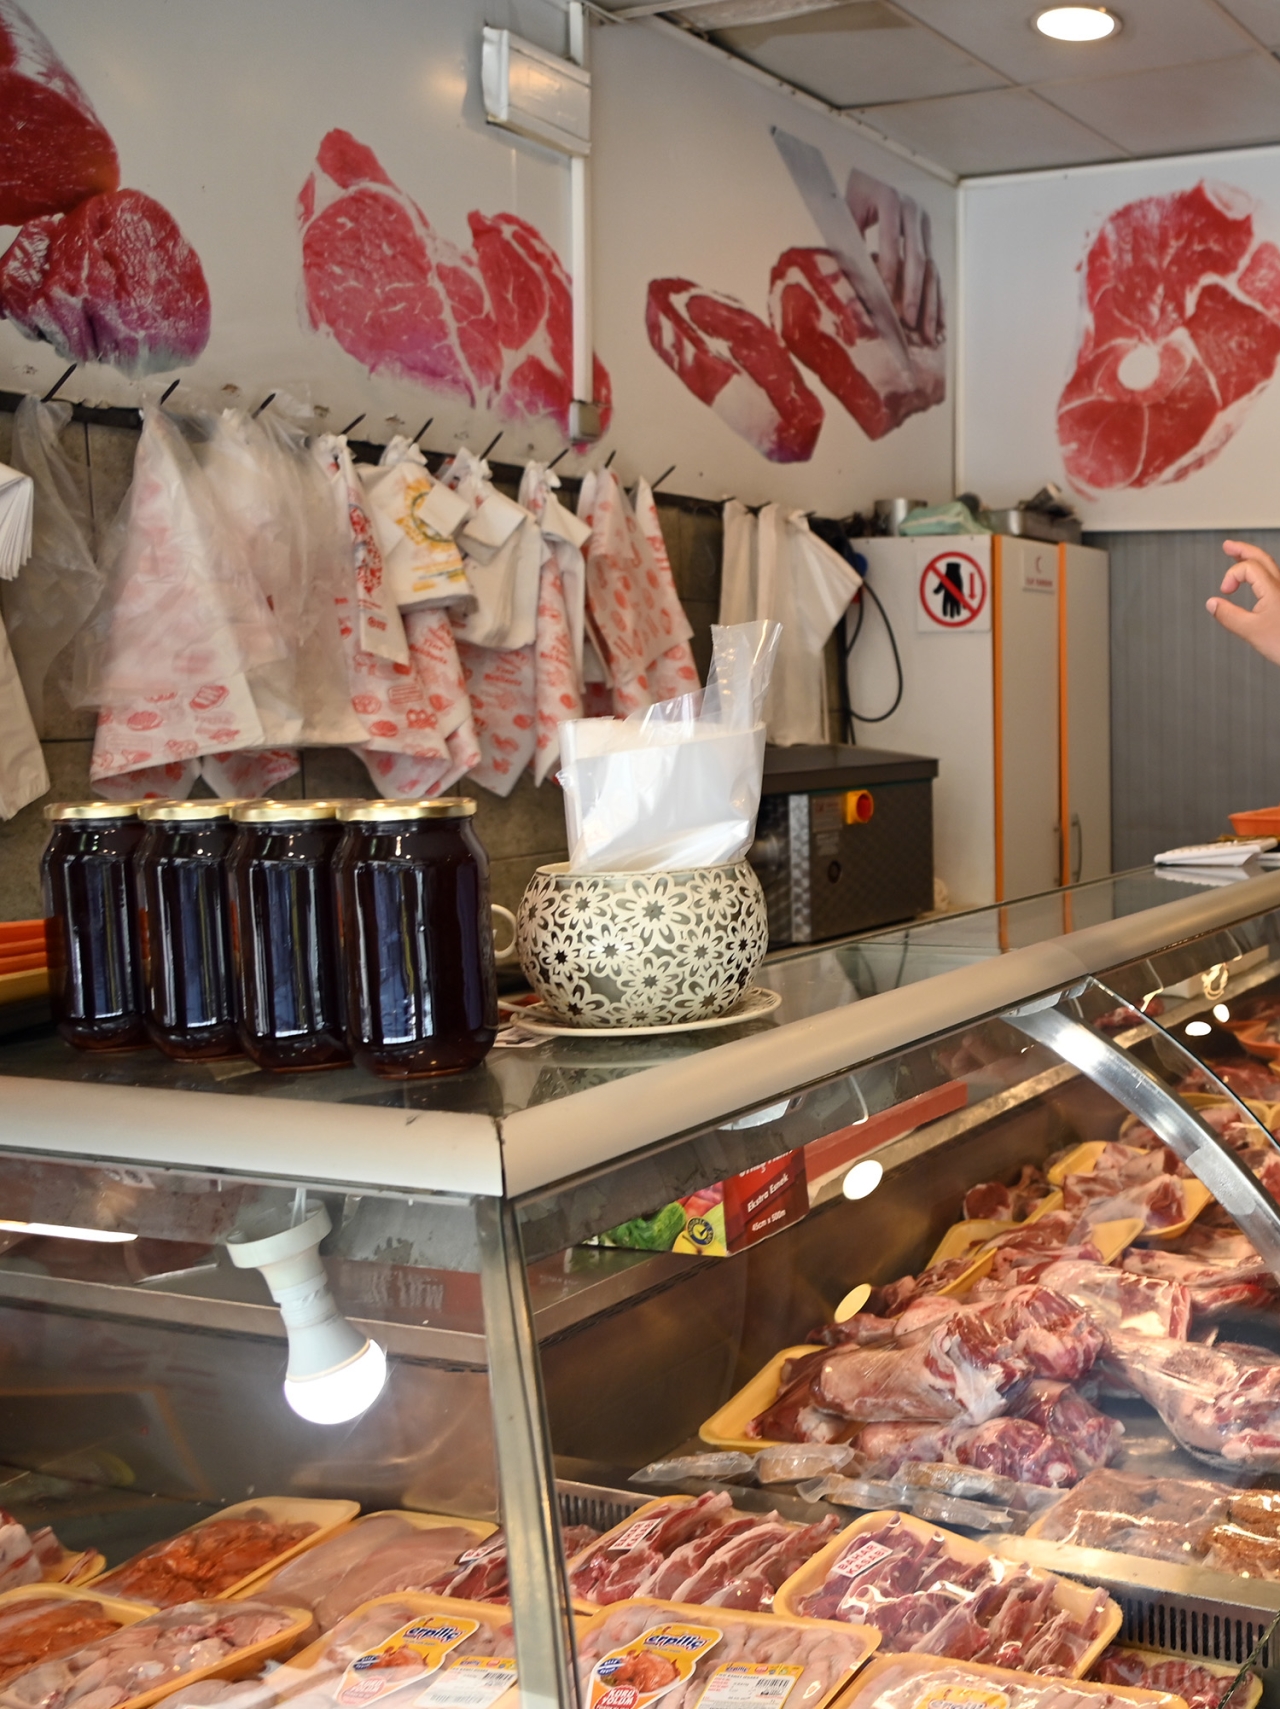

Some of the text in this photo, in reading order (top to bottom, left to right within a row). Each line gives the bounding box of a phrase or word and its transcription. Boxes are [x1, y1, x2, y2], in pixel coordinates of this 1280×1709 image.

[747, 1173, 789, 1213] Ekstra Esnek
[837, 1544, 877, 1570] BAHAR
[846, 1547, 890, 1574] KASABI
